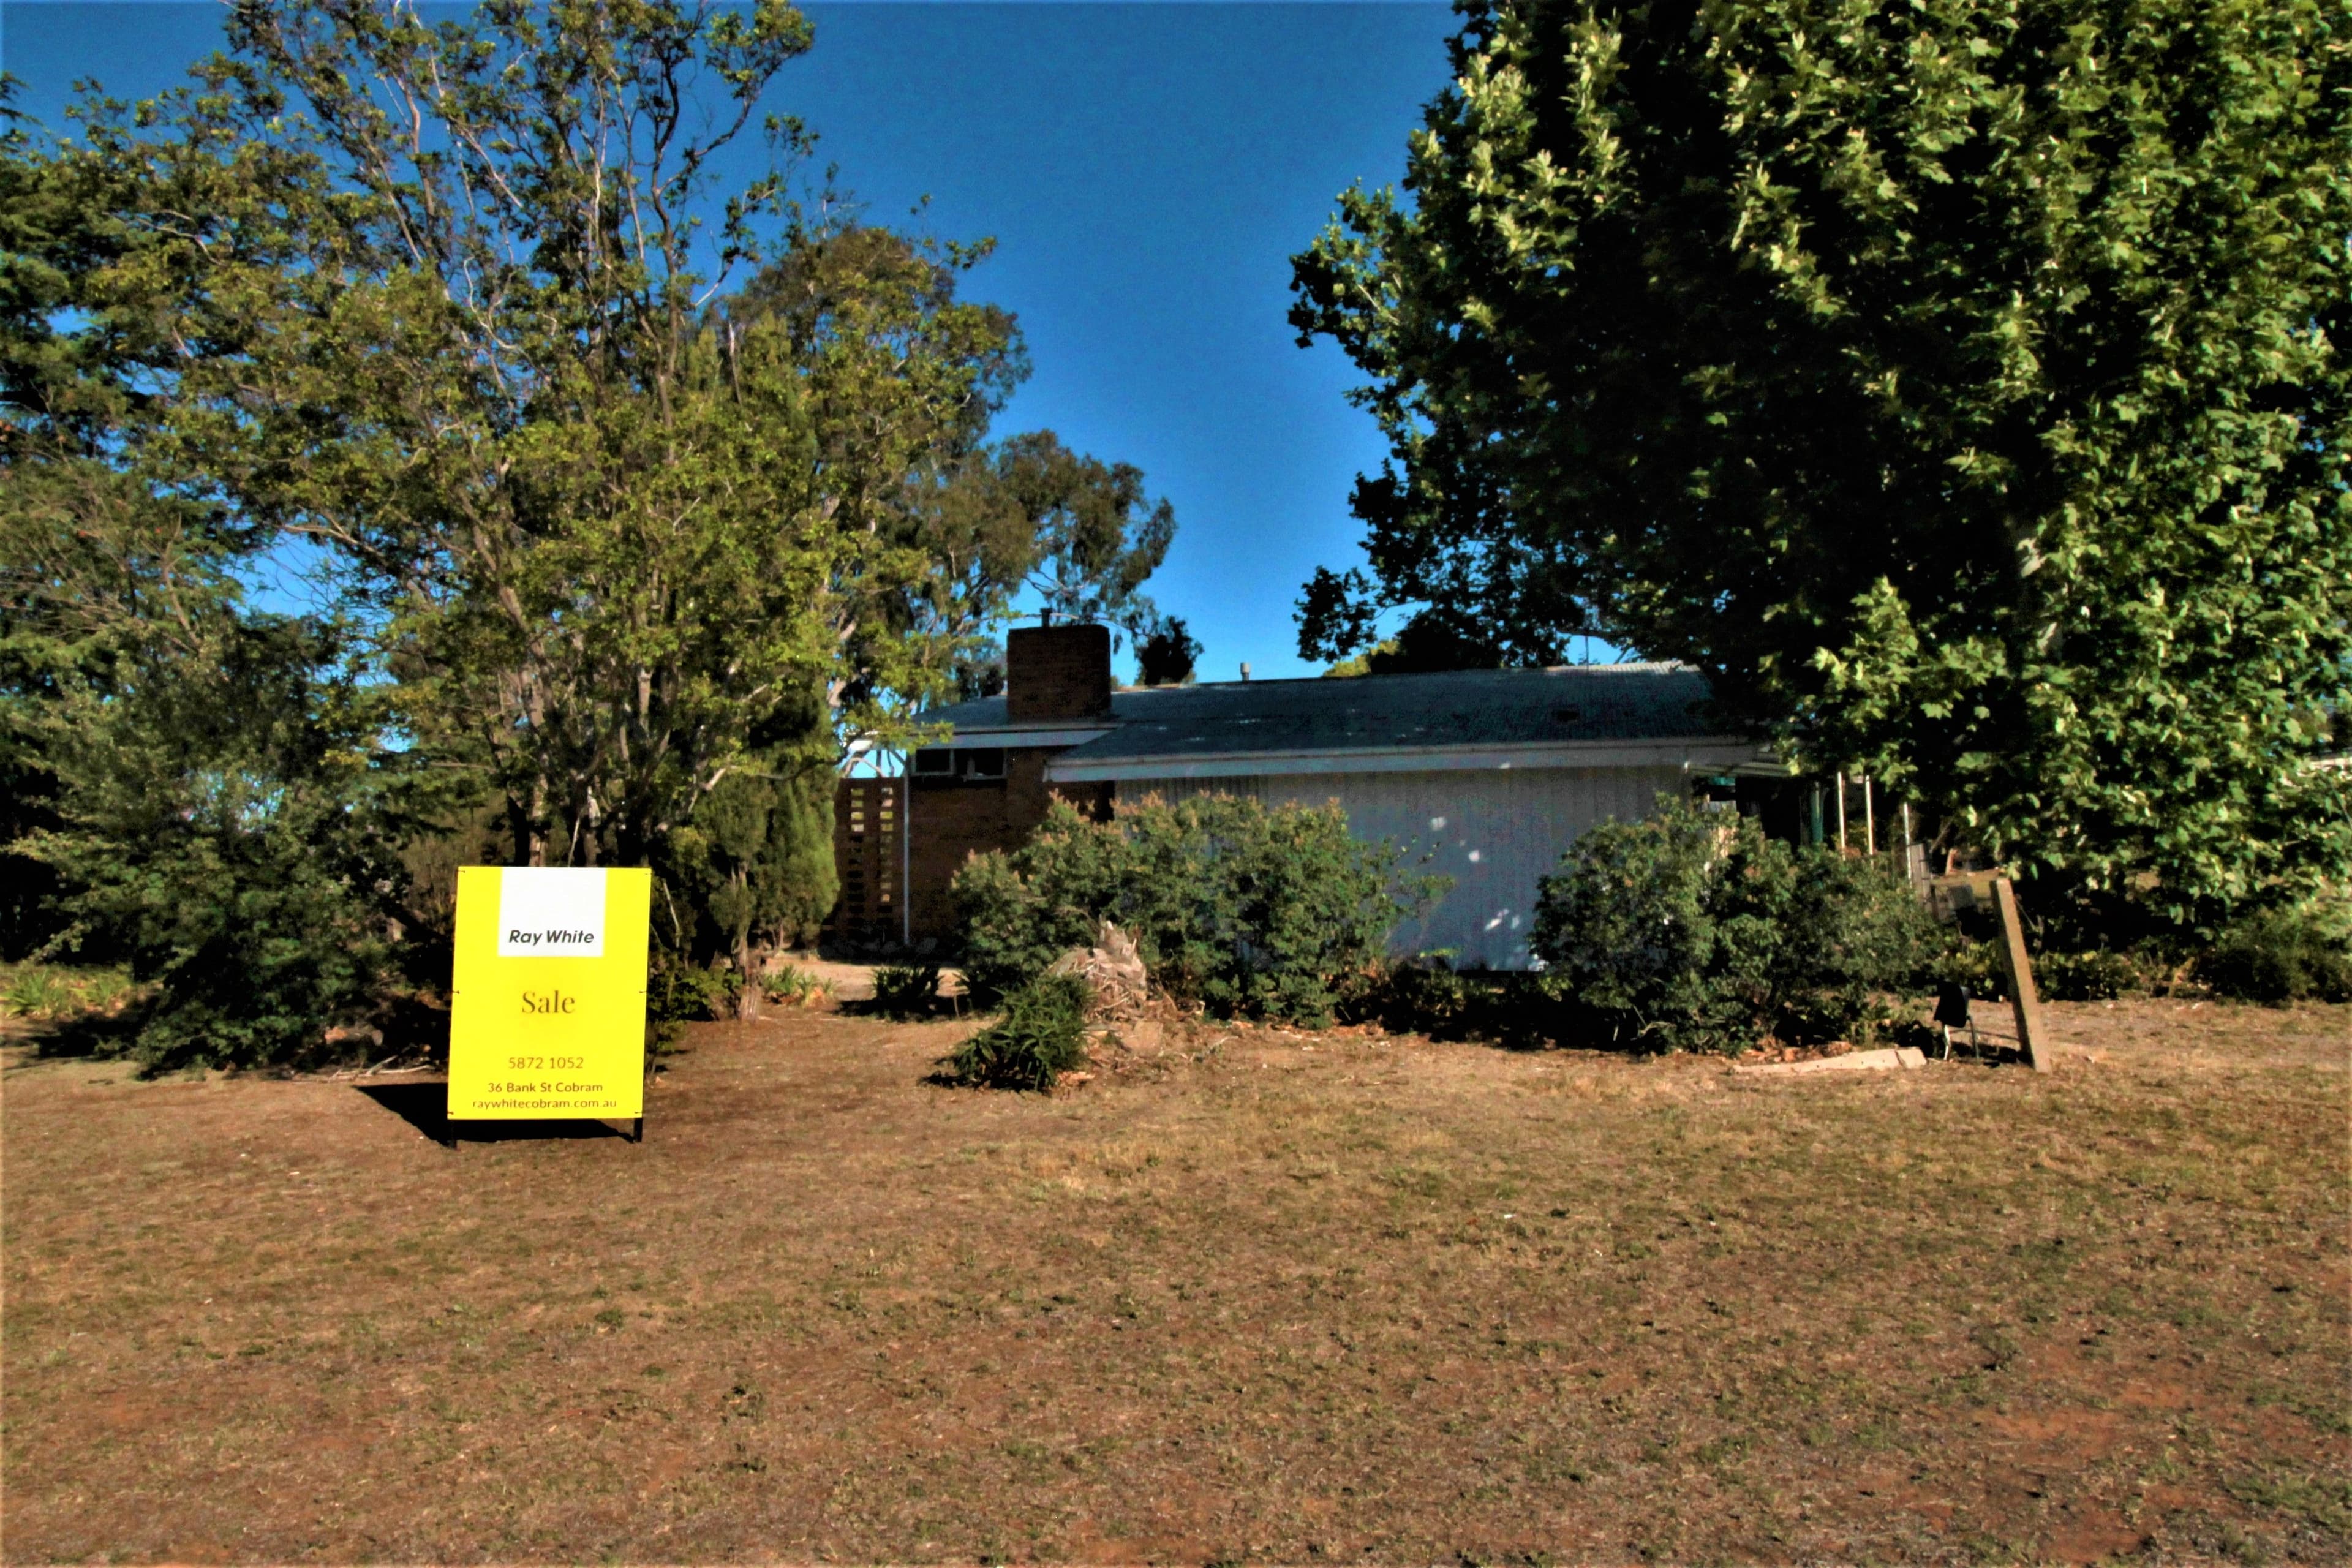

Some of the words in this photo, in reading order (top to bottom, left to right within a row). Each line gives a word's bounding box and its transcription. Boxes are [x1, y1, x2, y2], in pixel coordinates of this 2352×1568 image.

[509, 930, 542, 946] Ray
[546, 930, 594, 943] White
[522, 990, 575, 1014] Sale
[508, 1057, 543, 1069] 5872
[549, 1057, 584, 1069] 1052
[488, 1082, 502, 1093] 36
[507, 1082, 536, 1093] Bank
[540, 1082, 551, 1092] St
[556, 1082, 603, 1092] Cobram
[473, 1098, 617, 1110] raywhitecobram.com.au
